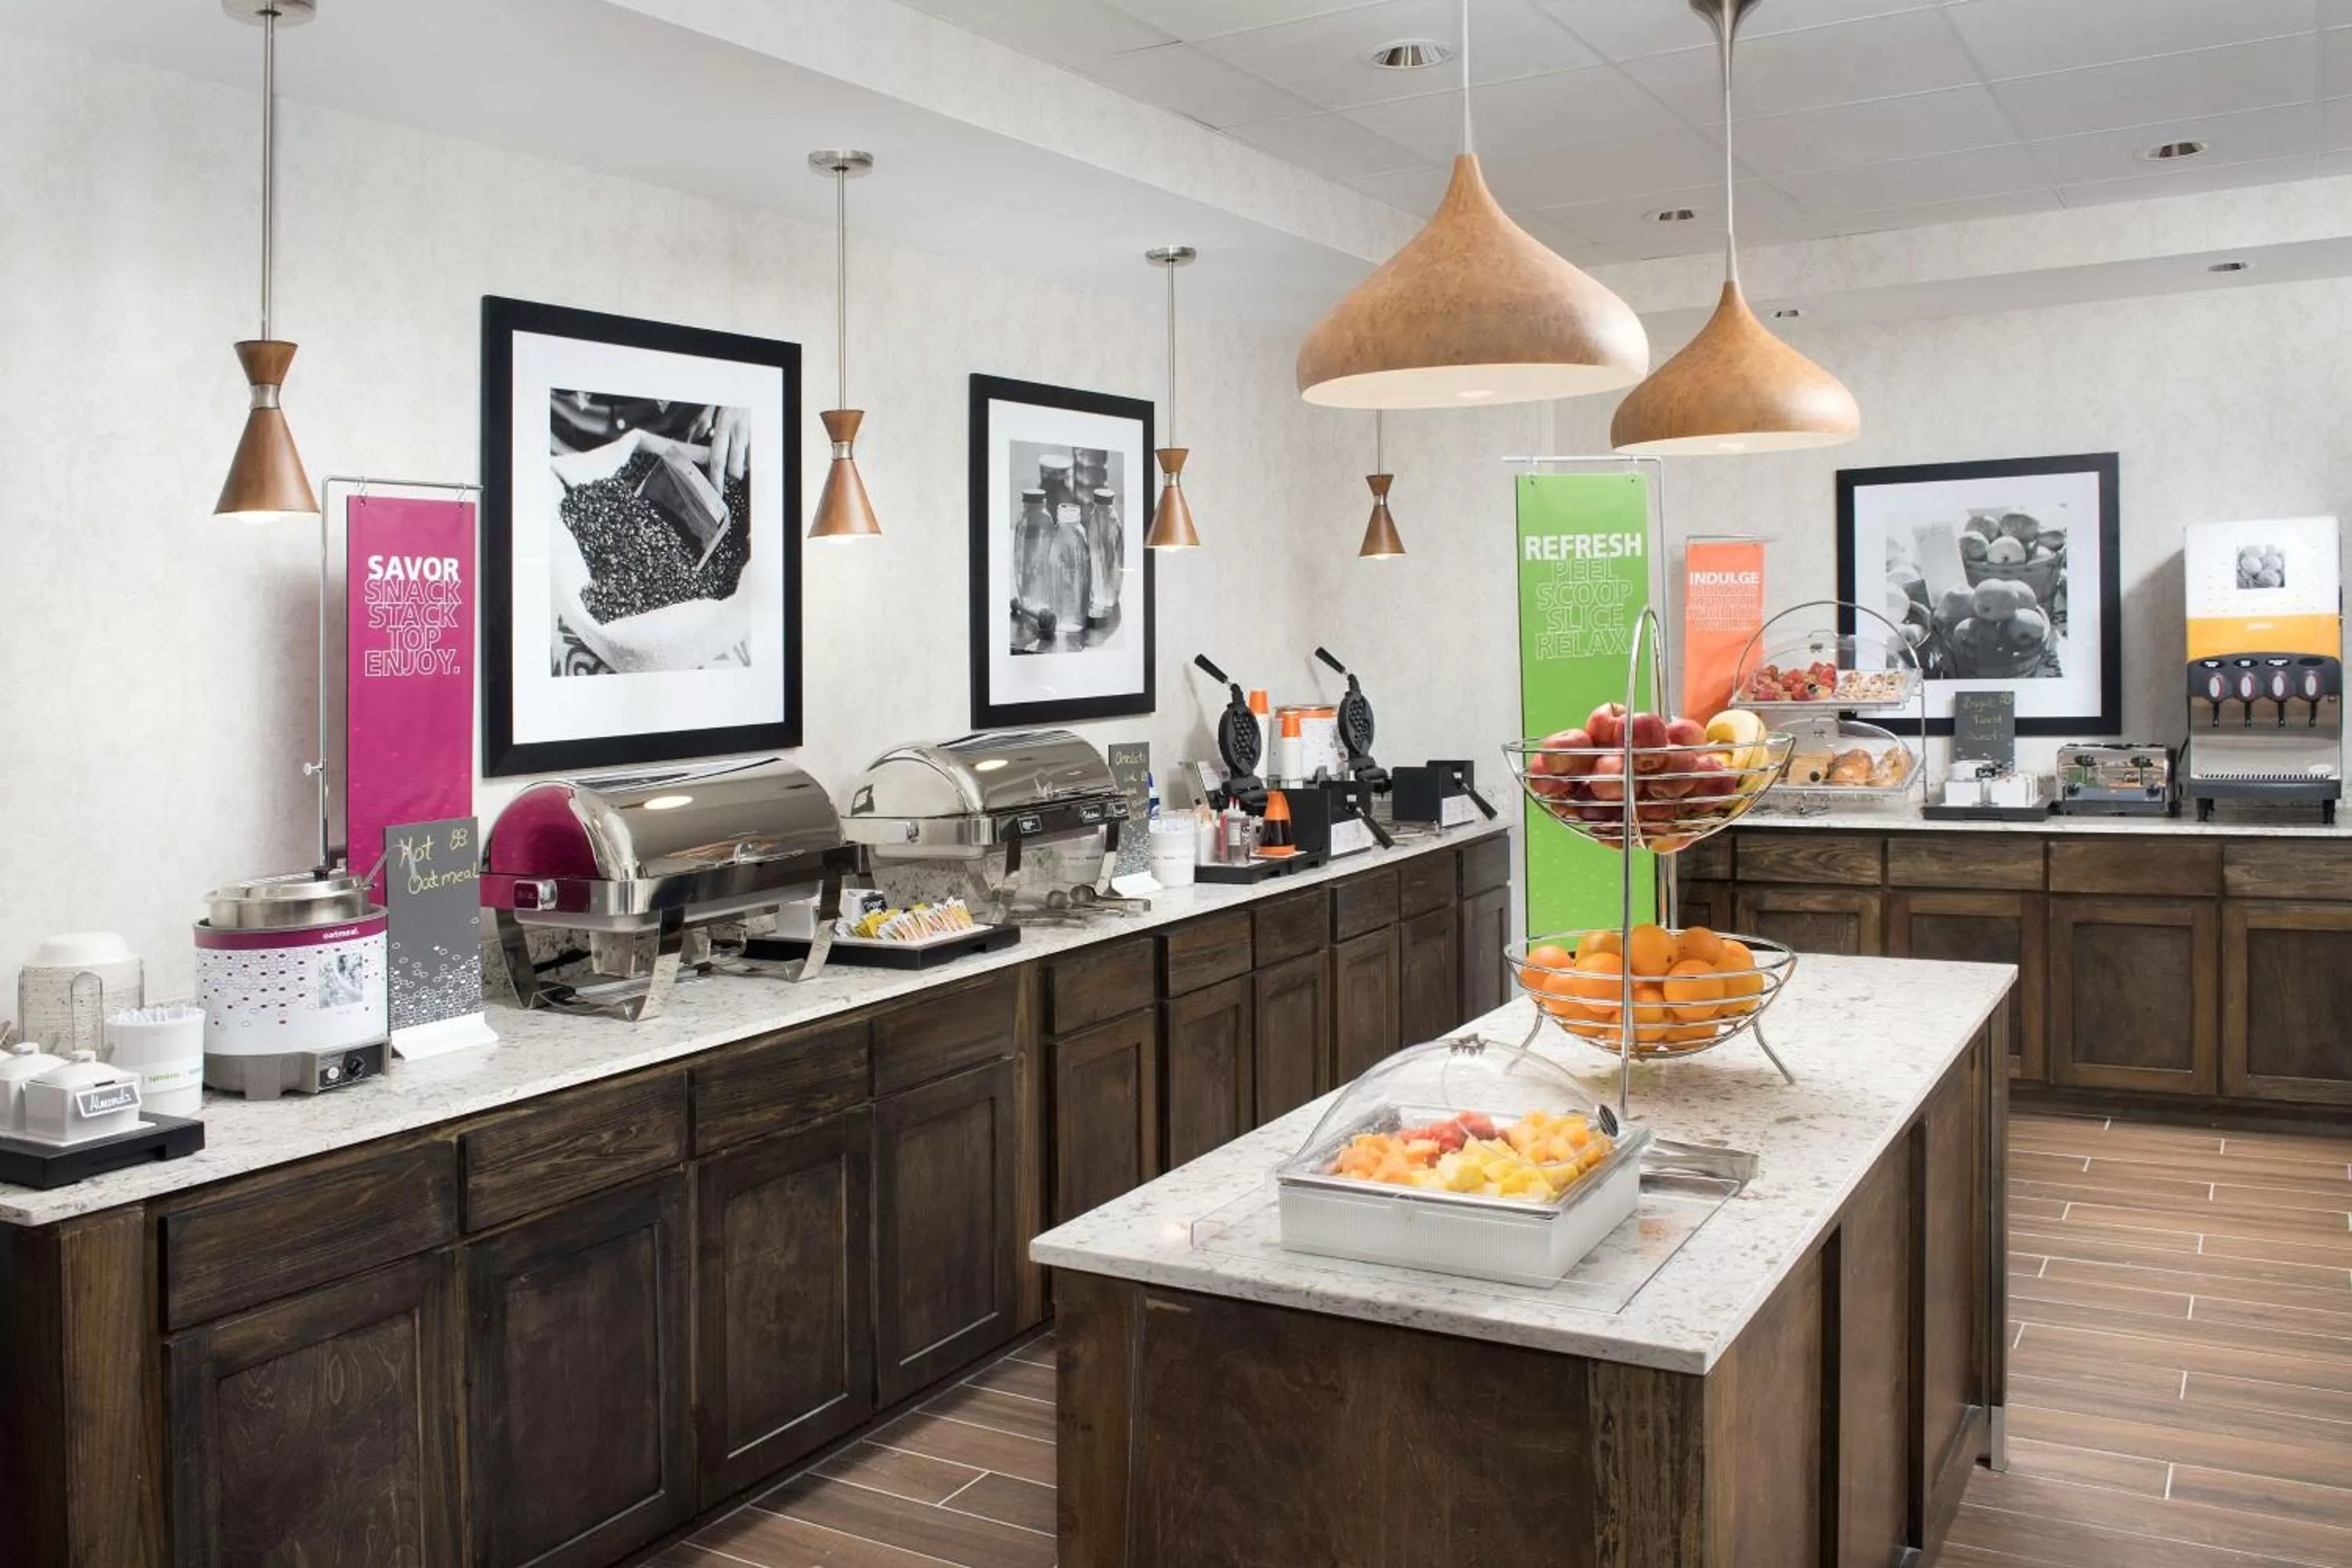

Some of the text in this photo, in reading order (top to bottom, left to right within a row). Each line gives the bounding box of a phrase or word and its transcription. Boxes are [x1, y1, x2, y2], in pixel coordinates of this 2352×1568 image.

[1524, 532, 1643, 561] REFRESH
[367, 554, 460, 582] SAVOR
[1553, 557, 1618, 583] PEEL
[1690, 572, 1759, 586] INDULGE
[365, 579, 463, 604] SNACK
[1536, 580, 1633, 611] SCOOP
[368, 603, 459, 628] STACK
[1546, 604, 1624, 633] SLICE
[387, 626, 442, 652] TOP
[365, 649, 461, 677] ENJOY.
[398, 835, 435, 869] Hot
[407, 862, 481, 895] Oatmeal
